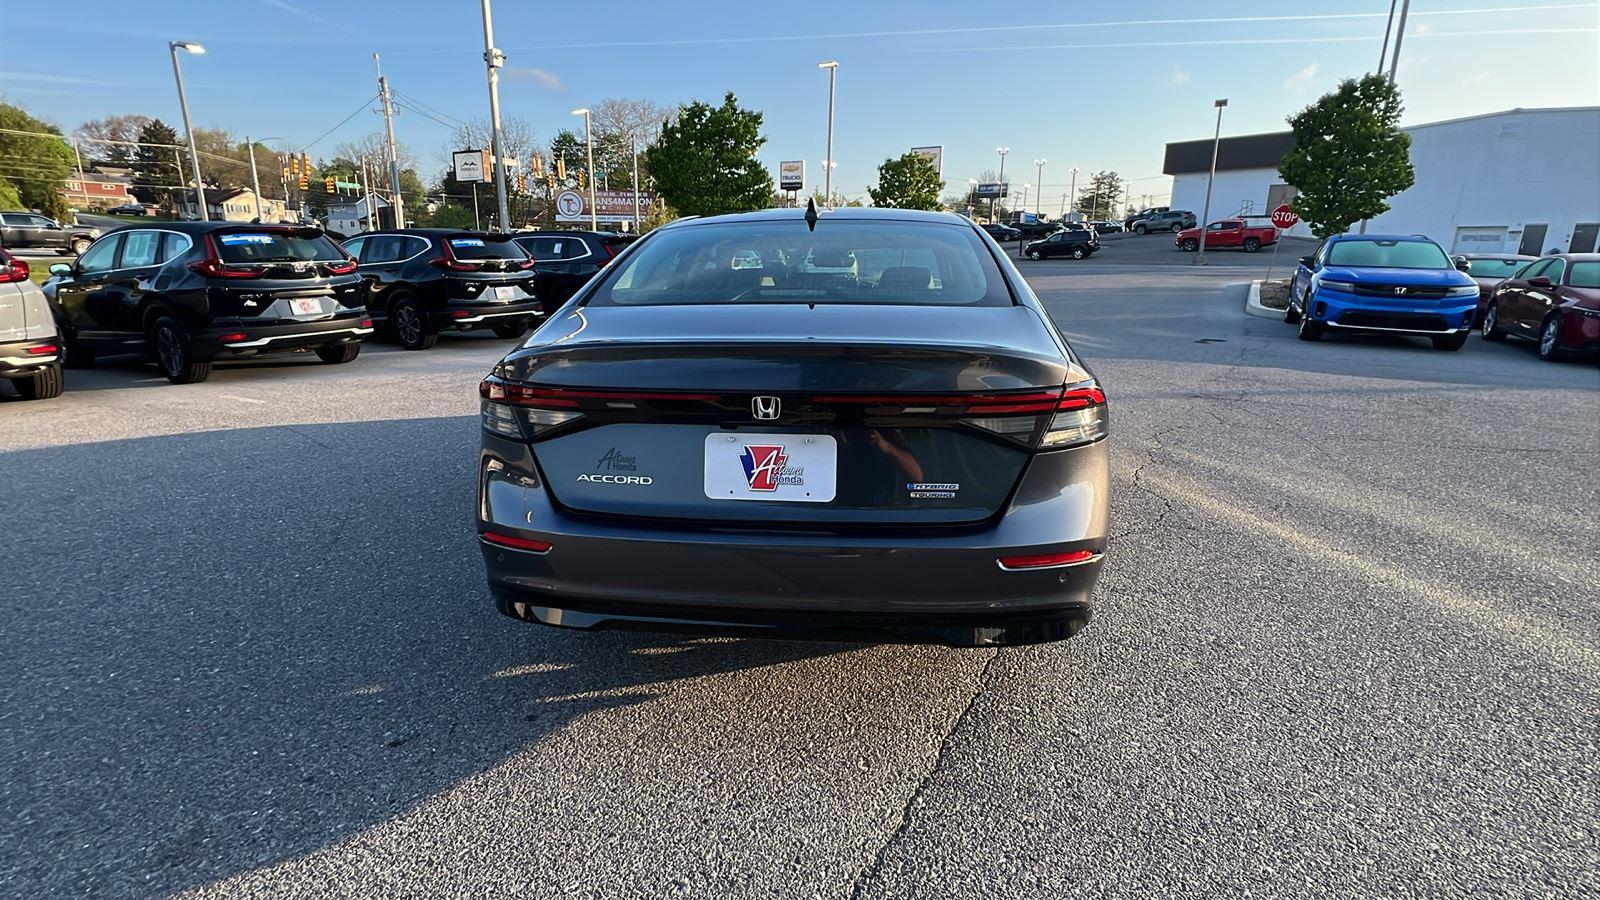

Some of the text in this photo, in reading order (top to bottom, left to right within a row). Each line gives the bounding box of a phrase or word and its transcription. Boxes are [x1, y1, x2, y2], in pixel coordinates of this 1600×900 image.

[583, 197, 653, 206] TANS4MATON
[1273, 211, 1298, 222] STOP
[613, 463, 637, 471] Honda
[576, 473, 653, 485] ACCORD
[771, 474, 803, 485] Honda
[914, 483, 957, 491] HYBRID
[911, 491, 954, 499] TOURING
